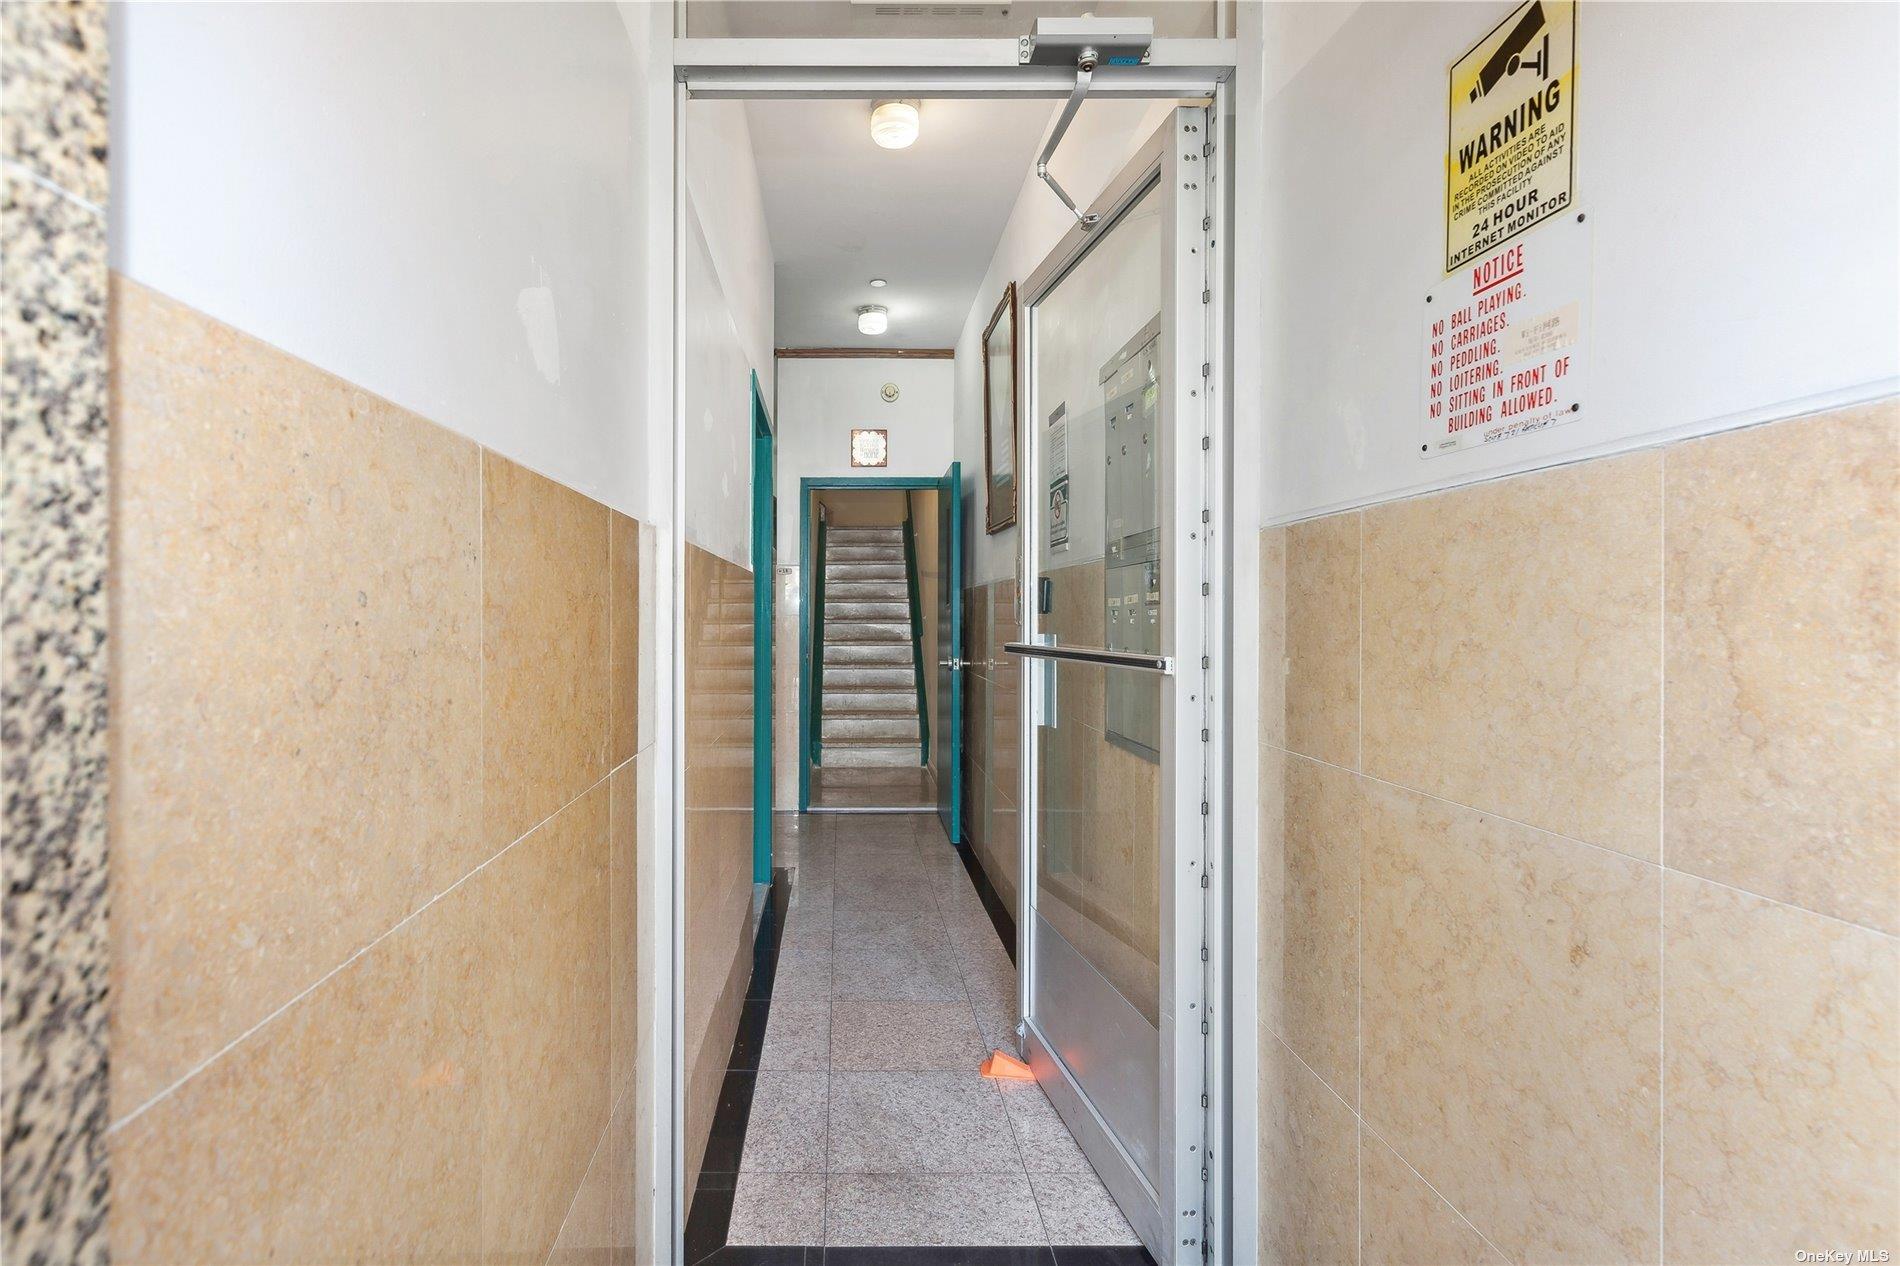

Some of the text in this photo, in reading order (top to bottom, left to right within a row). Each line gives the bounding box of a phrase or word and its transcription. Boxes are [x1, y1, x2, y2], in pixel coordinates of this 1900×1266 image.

[1459, 79, 1560, 174] WARNING
[1469, 124, 1546, 182] ALL ACTIVITIES ARE
[1452, 132, 1566, 213] IN THE PROSECUTION OF ANY
[1454, 123, 1565, 202] RECORDED ON VIDEO TO AID
[1454, 145, 1564, 221] CRIME COMMITTED AGAINST
[1472, 188, 1538, 239] 24 HOUR
[1478, 175, 1532, 215] THIS FACILITY
[1450, 191, 1567, 265] INTERNET MONITOR
[1473, 244, 1523, 289] NOTICE
[1431, 340, 1444, 358] NO
[1451, 312, 1509, 350] CARRIAGES.
[1432, 282, 1526, 338] NO BALL PLAYING.
[1430, 359, 1503, 399] NO LOITERING.
[1431, 360, 1443, 379] NO
[1450, 338, 1500, 371] PEDDLING.
[1430, 356, 1570, 419] NO SITTING IN FRONT OF
[1448, 405, 1492, 433] BUILDING
[1500, 386, 1557, 418] ALLOWED.
[1508, 417, 1540, 431] penalty
[1542, 412, 1552, 420] of
